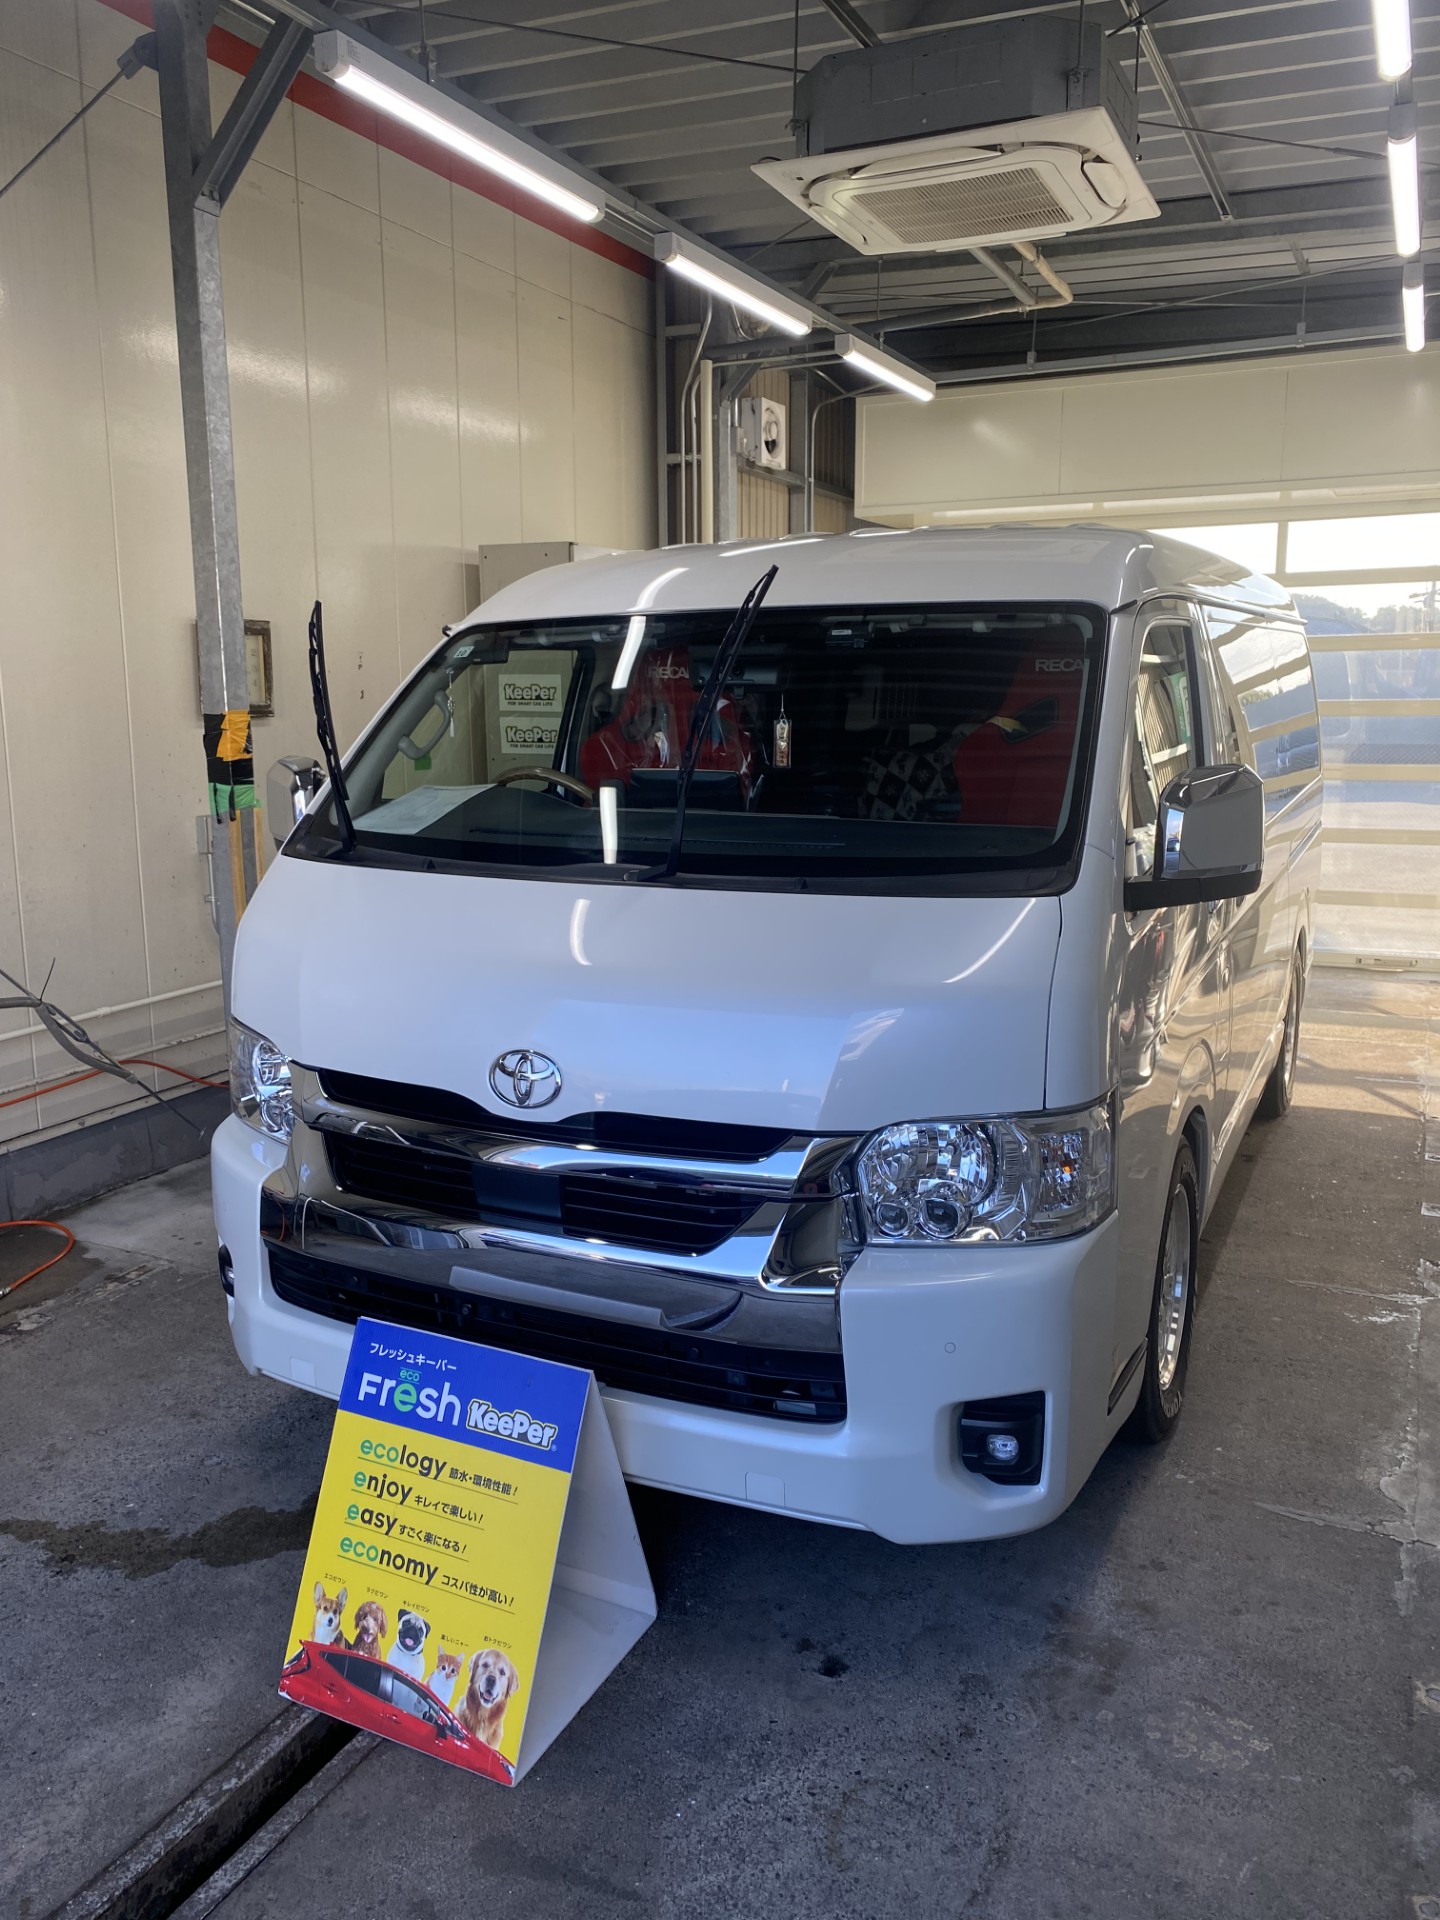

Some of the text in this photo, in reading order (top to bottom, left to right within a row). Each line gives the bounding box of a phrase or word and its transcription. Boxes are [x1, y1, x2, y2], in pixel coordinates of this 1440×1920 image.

[649, 666, 689, 678] RECA
[1035, 659, 1083, 671] RECA
[504, 684, 556, 700] KeePer
[506, 726, 557, 743] KeePer
[400, 1369, 420, 1382] eco
[358, 1372, 558, 1450] Fresh KeePer
[360, 1439, 447, 1480] ecology
[354, 1471, 483, 1523] enjoy キレイで楽しい！
[347, 1504, 467, 1554] easy すごく楽になる！
[340, 1536, 439, 1585] economy
